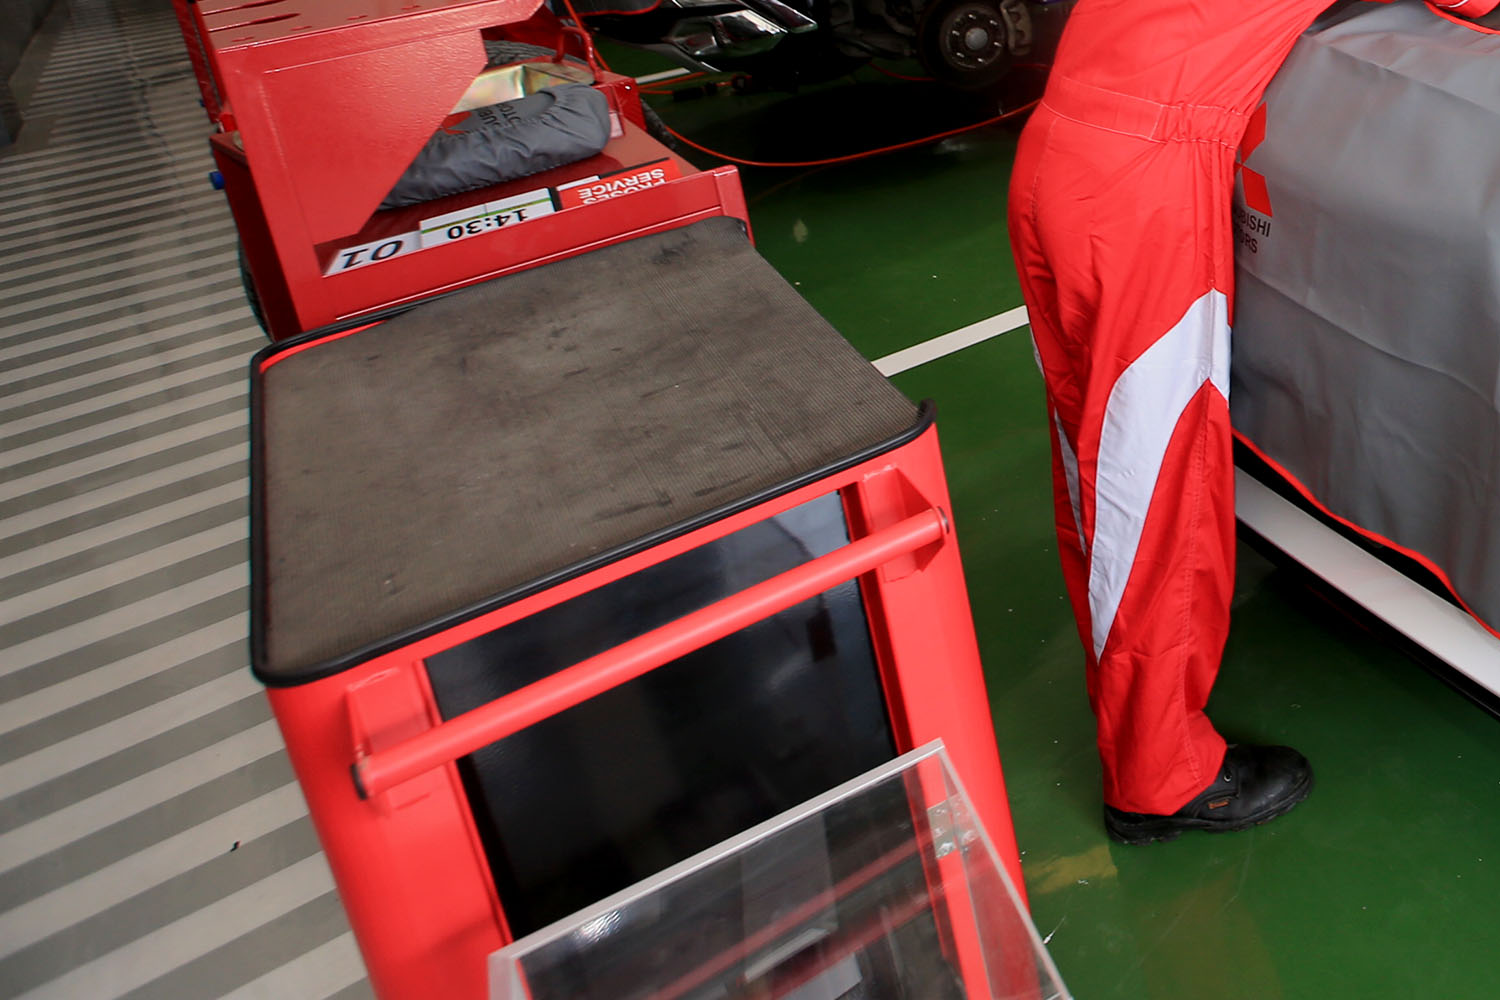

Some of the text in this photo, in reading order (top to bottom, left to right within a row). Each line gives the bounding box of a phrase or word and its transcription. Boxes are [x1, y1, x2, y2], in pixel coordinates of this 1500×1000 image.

[577, 168, 665, 199] SERVICE
[446, 208, 529, 241] 14:30
[341, 239, 404, 270] 01
